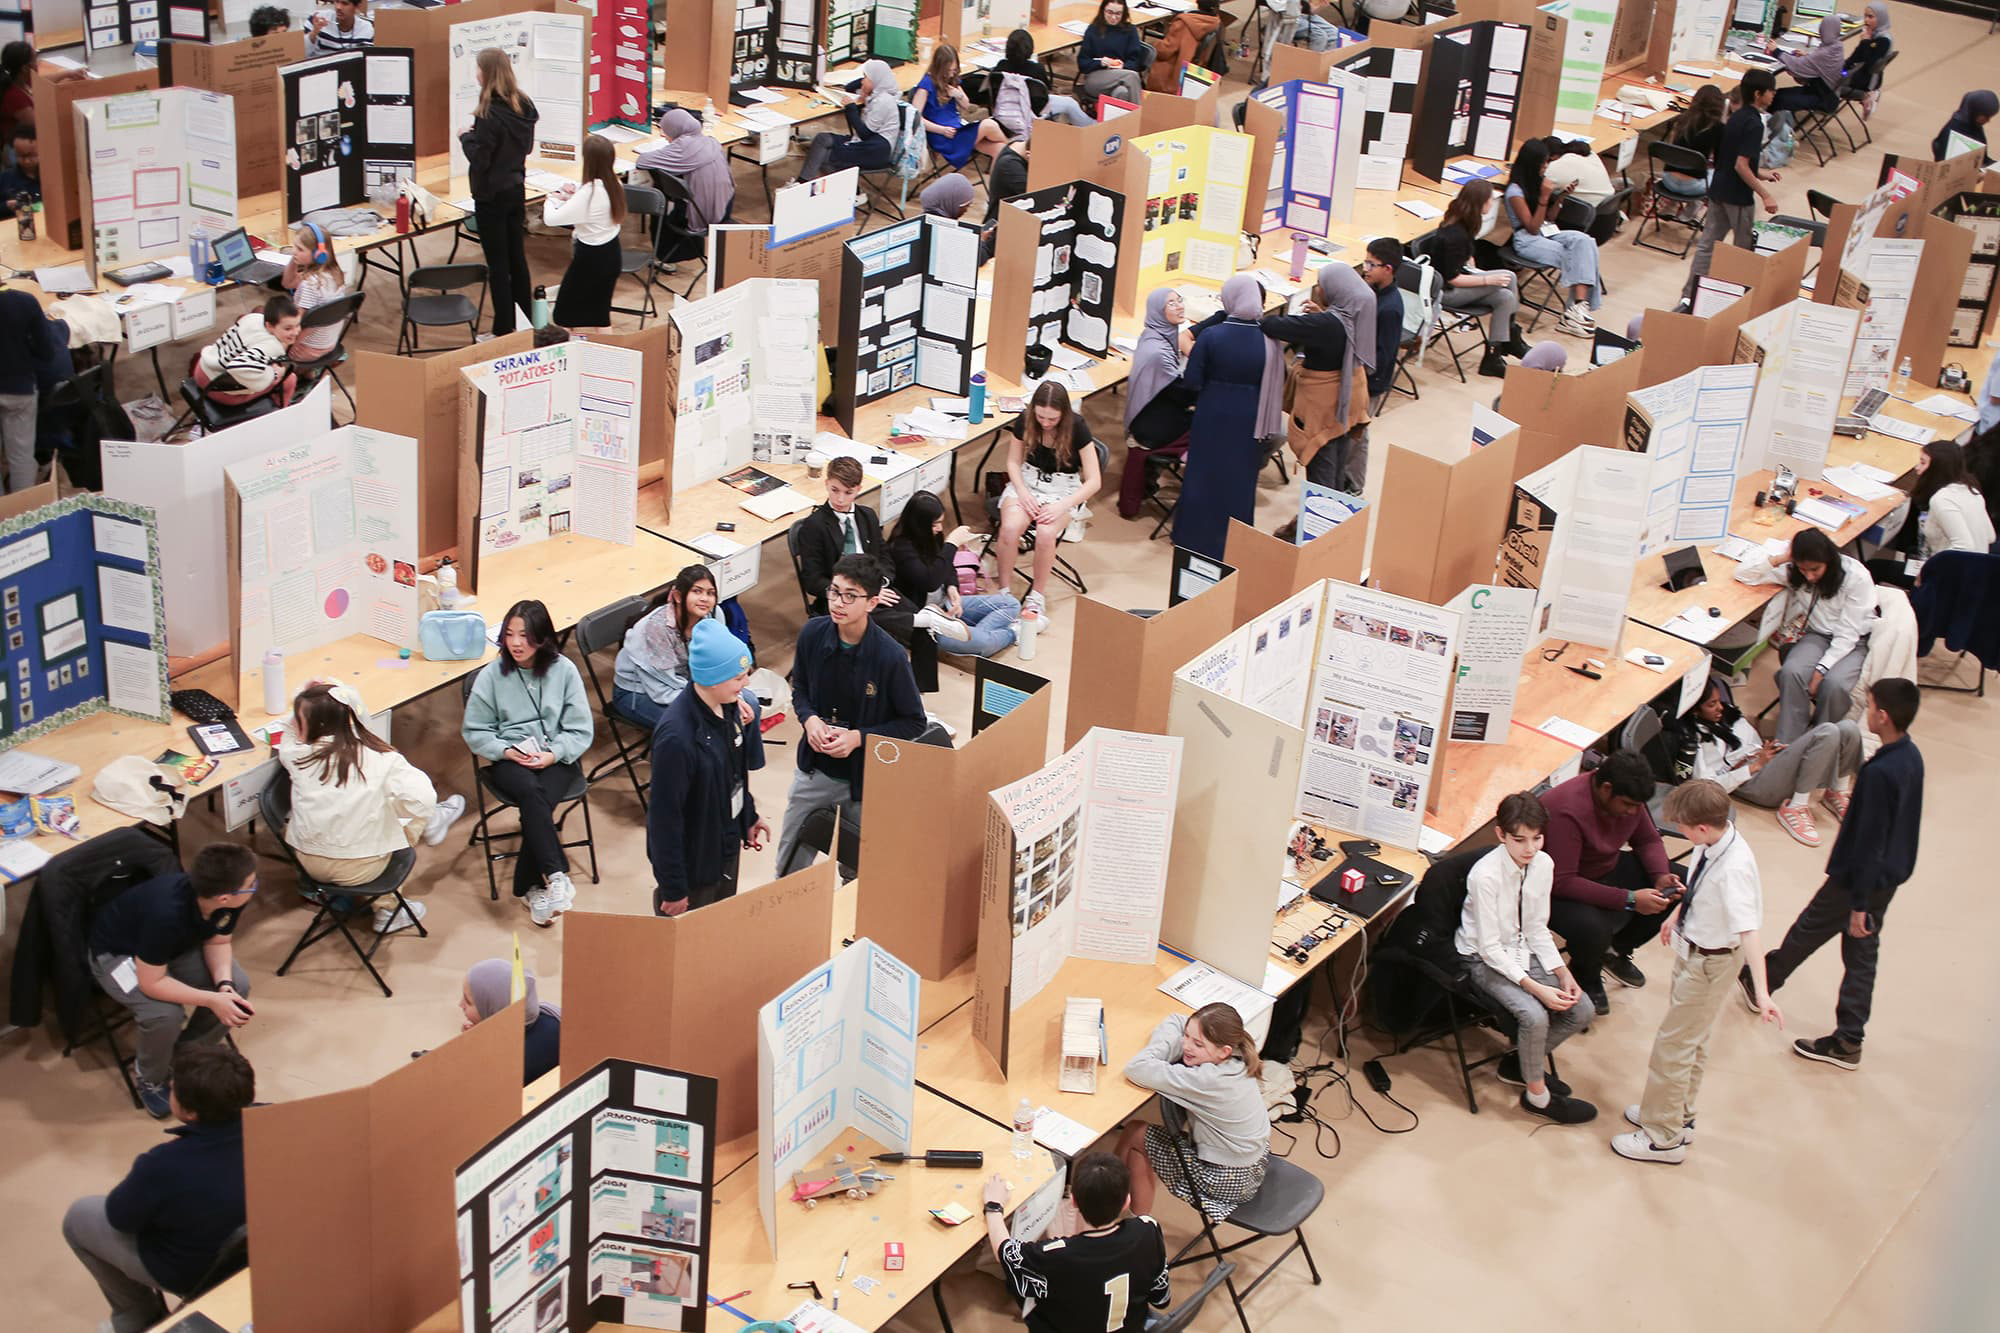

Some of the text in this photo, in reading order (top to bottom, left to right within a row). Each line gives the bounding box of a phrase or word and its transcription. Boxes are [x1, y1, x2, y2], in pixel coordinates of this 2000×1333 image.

[494, 352, 541, 373] SHRANK
[546, 346, 567, 358] THE
[498, 362, 555, 386] POTATOES
[580, 430, 624, 448] RESULT
[1189, 649, 1228, 680] Building
[1381, 685, 1423, 700] Modifications
[1312, 748, 1357, 766] Conclusions
[1367, 764, 1392, 776] Future
[1394, 772, 1414, 781] Work
[1004, 787, 1023, 804] Will
[1025, 783, 1032, 793] A
[1034, 761, 1070, 789] Popsicle
[1013, 795, 1043, 815] Bridge
[1047, 782, 1065, 800] Hold
[1037, 807, 1050, 823] Of
[1049, 805, 1056, 814] A
[784, 983, 824, 1013] Balloon Cars
[595, 1111, 690, 1131] HARMONOGRAPH
[457, 1079, 608, 1199] Harmonograph
[593, 1179, 627, 1193] DESIGN
[493, 1243, 522, 1269] DESIGN
[591, 1243, 626, 1257] DESIGN
[1105, 1273, 1130, 1333] 1
